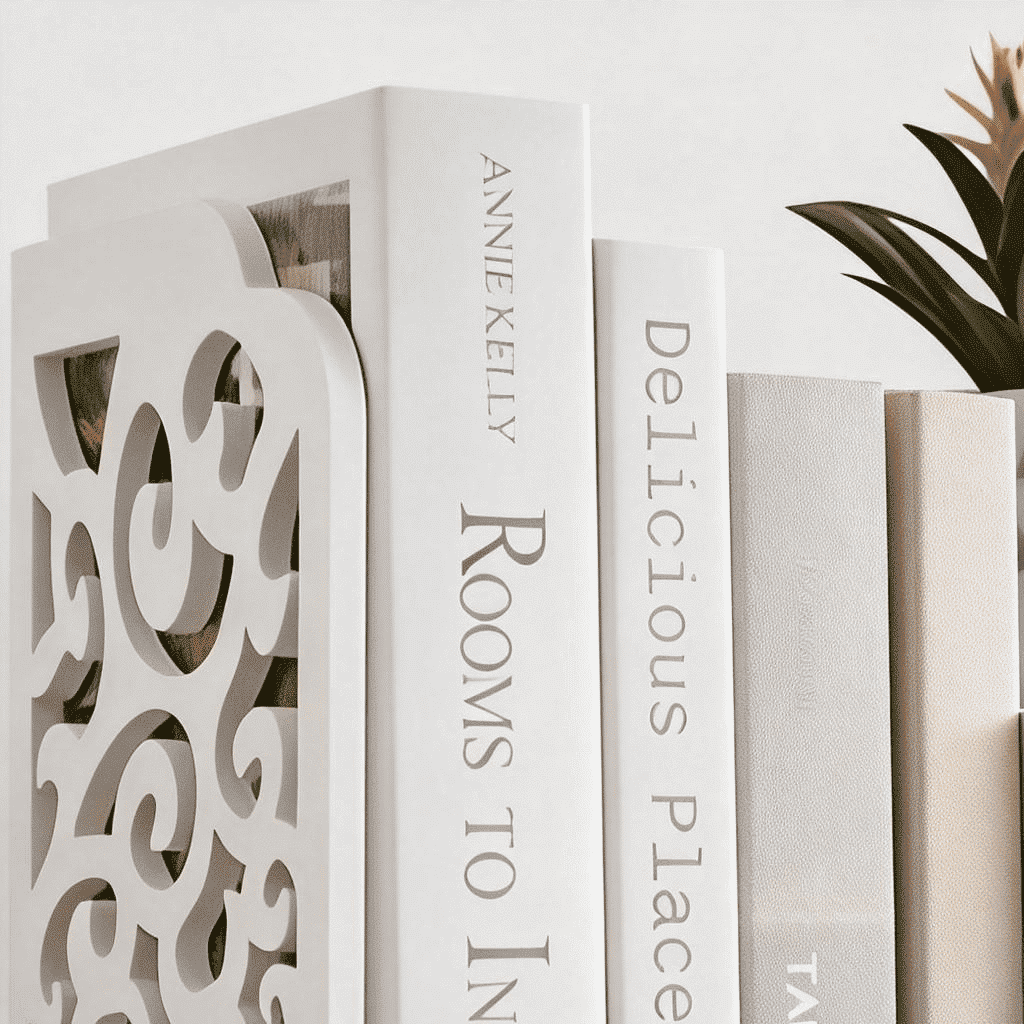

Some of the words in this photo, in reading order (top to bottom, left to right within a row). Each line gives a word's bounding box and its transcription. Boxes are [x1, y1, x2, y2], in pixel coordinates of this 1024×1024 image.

[480, 152, 514, 295] ANNIE
[485, 304, 517, 445] KELLY
[645, 319, 698, 736] Delicious
[459, 501, 547, 771] ROOMS
[463, 806, 517, 901] TO
